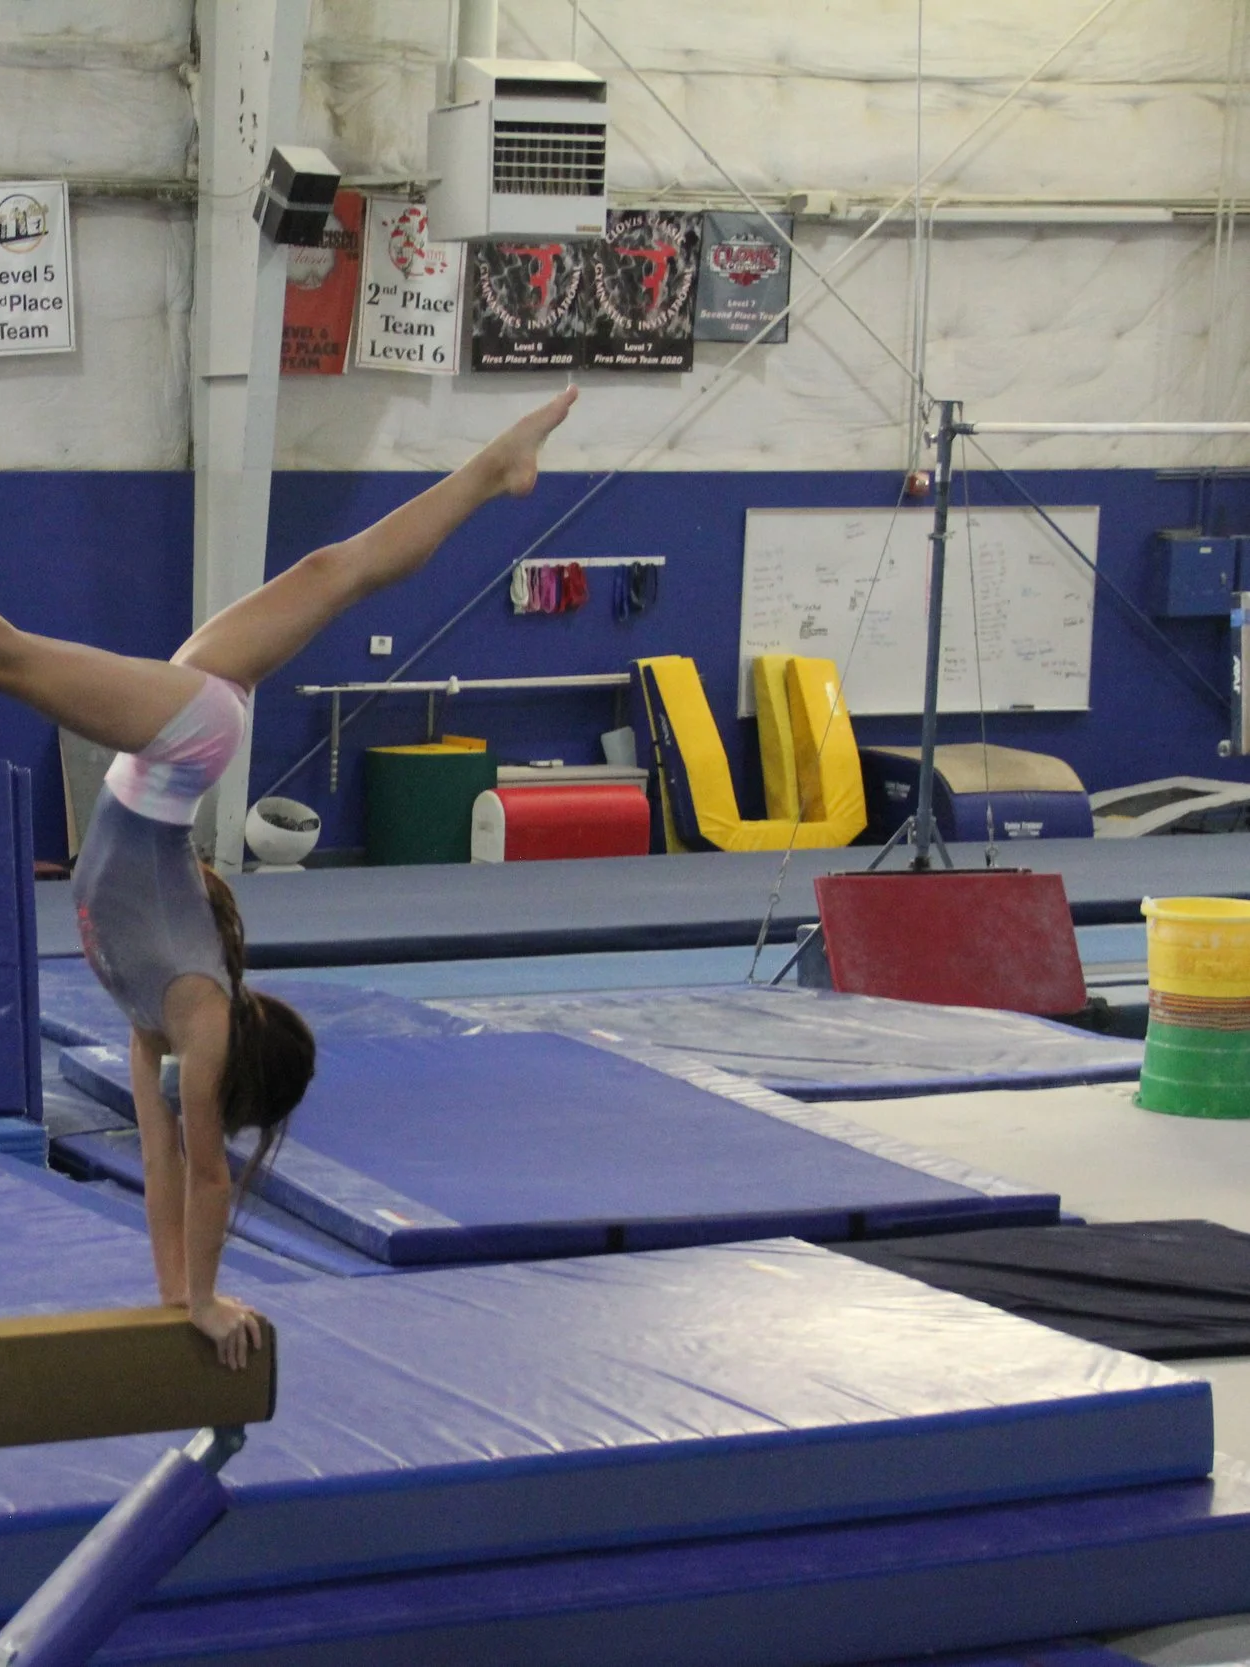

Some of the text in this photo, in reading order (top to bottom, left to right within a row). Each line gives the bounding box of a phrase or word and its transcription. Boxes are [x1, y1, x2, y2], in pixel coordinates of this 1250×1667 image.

[604, 216, 687, 244] CLOVIS CLASSIC
[43, 265, 55, 282] 5
[10, 294, 63, 312] Place
[366, 283, 455, 313] 2nd Place
[478, 262, 584, 330] GYMNASTICS INVITATIONAL
[595, 262, 696, 331] GYMNASTICS INVITATIONAL
[727, 300, 749, 308] Level
[700, 309, 732, 319] Second
[734, 311, 757, 320] Place
[380, 314, 435, 337] Team
[369, 340, 445, 364] Level 6
[514, 342, 535, 351] Level
[625, 342, 653, 352] Level 7
[482, 354, 573, 364] First Place Team 2020
[594, 354, 684, 365] First Place Team 2020
